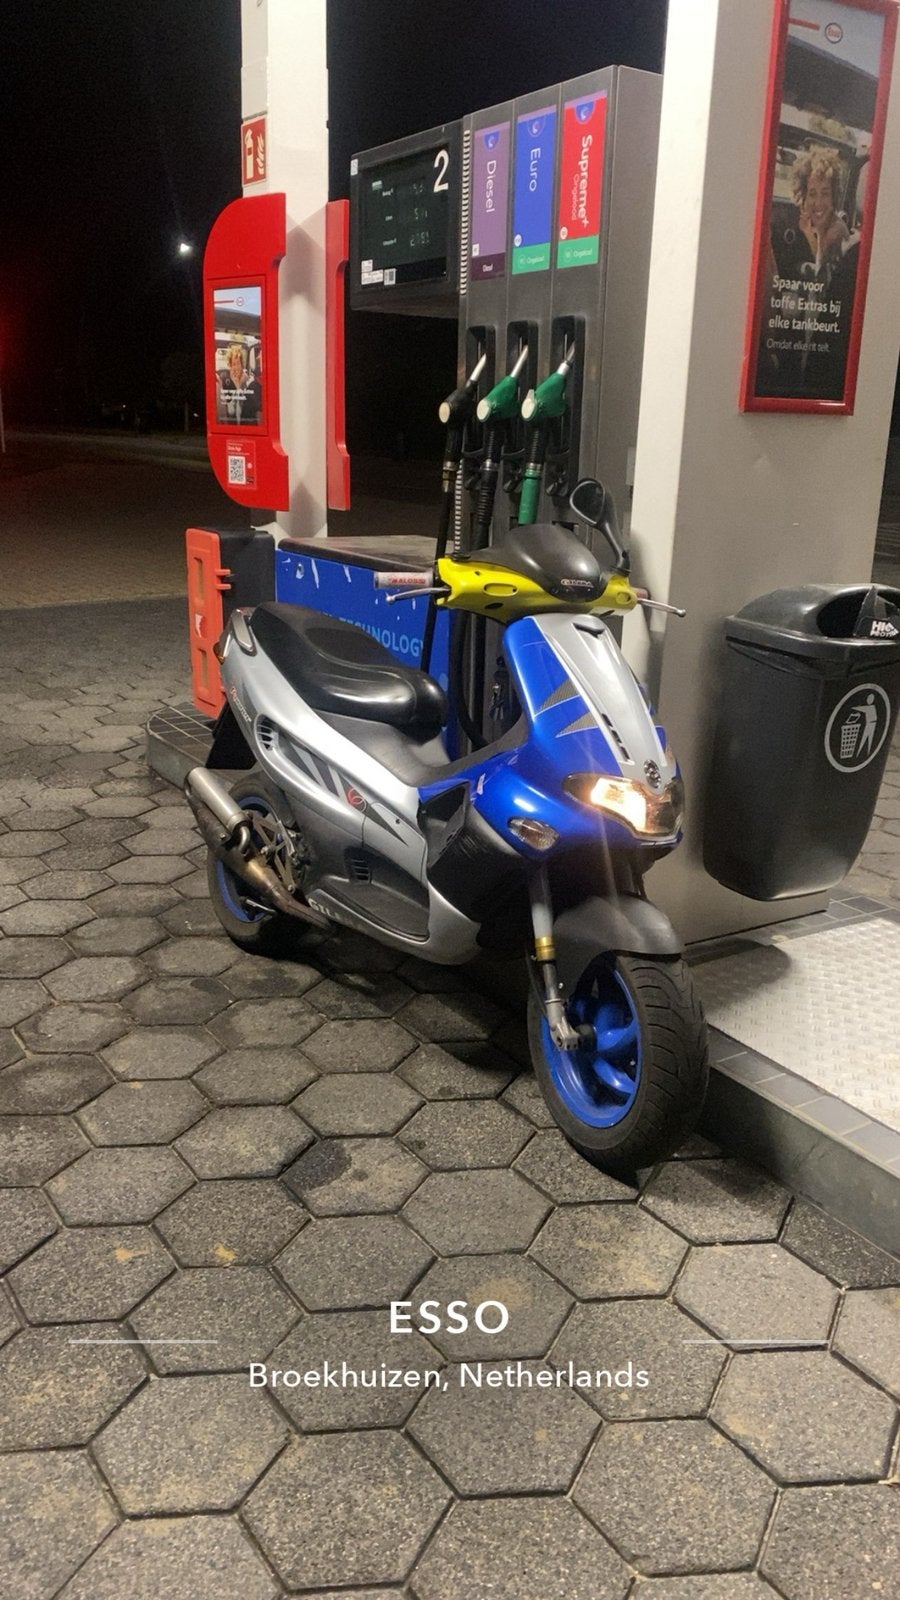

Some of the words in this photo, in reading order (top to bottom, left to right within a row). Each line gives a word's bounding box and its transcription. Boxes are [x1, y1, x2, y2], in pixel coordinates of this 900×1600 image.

[433, 149, 449, 193] 2
[529, 147, 541, 192] Euro
[486, 160, 497, 213] Diesel
[772, 274, 801, 292] Spaar
[803, 281, 825, 292] voor
[770, 295, 796, 310] toffe
[797, 297, 828, 313] Extras
[829, 300, 841, 317] bij
[768, 315, 790, 329] elke
[792, 317, 840, 333] tankbeurt.
[766, 338, 792, 350] Omdat
[793, 340, 808, 351] elke
